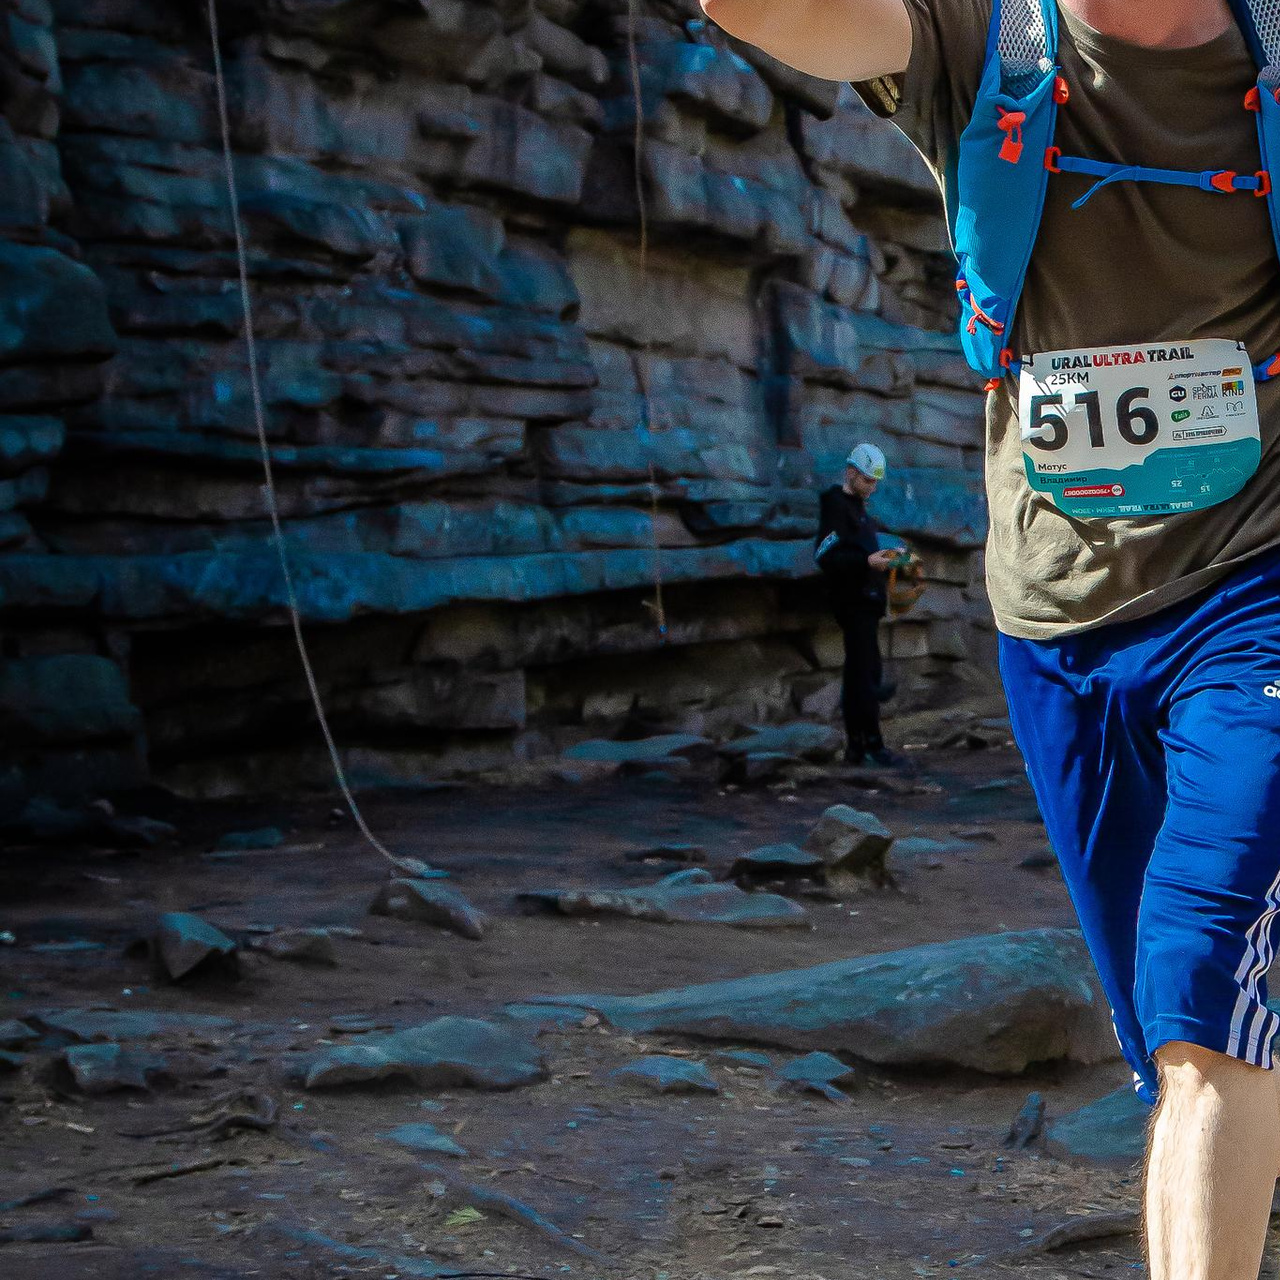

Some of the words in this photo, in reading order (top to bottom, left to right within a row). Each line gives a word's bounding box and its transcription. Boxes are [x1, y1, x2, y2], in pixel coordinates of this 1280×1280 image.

[1052, 355, 1092, 370] URAL
[1092, 351, 1145, 367] ULTRA
[1147, 347, 1194, 362] TRAIL
[1051, 371, 1089, 385] 25KM
[1192, 384, 1217, 394] SPORT
[1222, 389, 1245, 398] KIND
[1193, 391, 1219, 400] FERMA
[1030, 386, 1159, 451] 516
[1038, 463, 1067, 473] Мотус
[1040, 476, 1088, 485] Владимир
